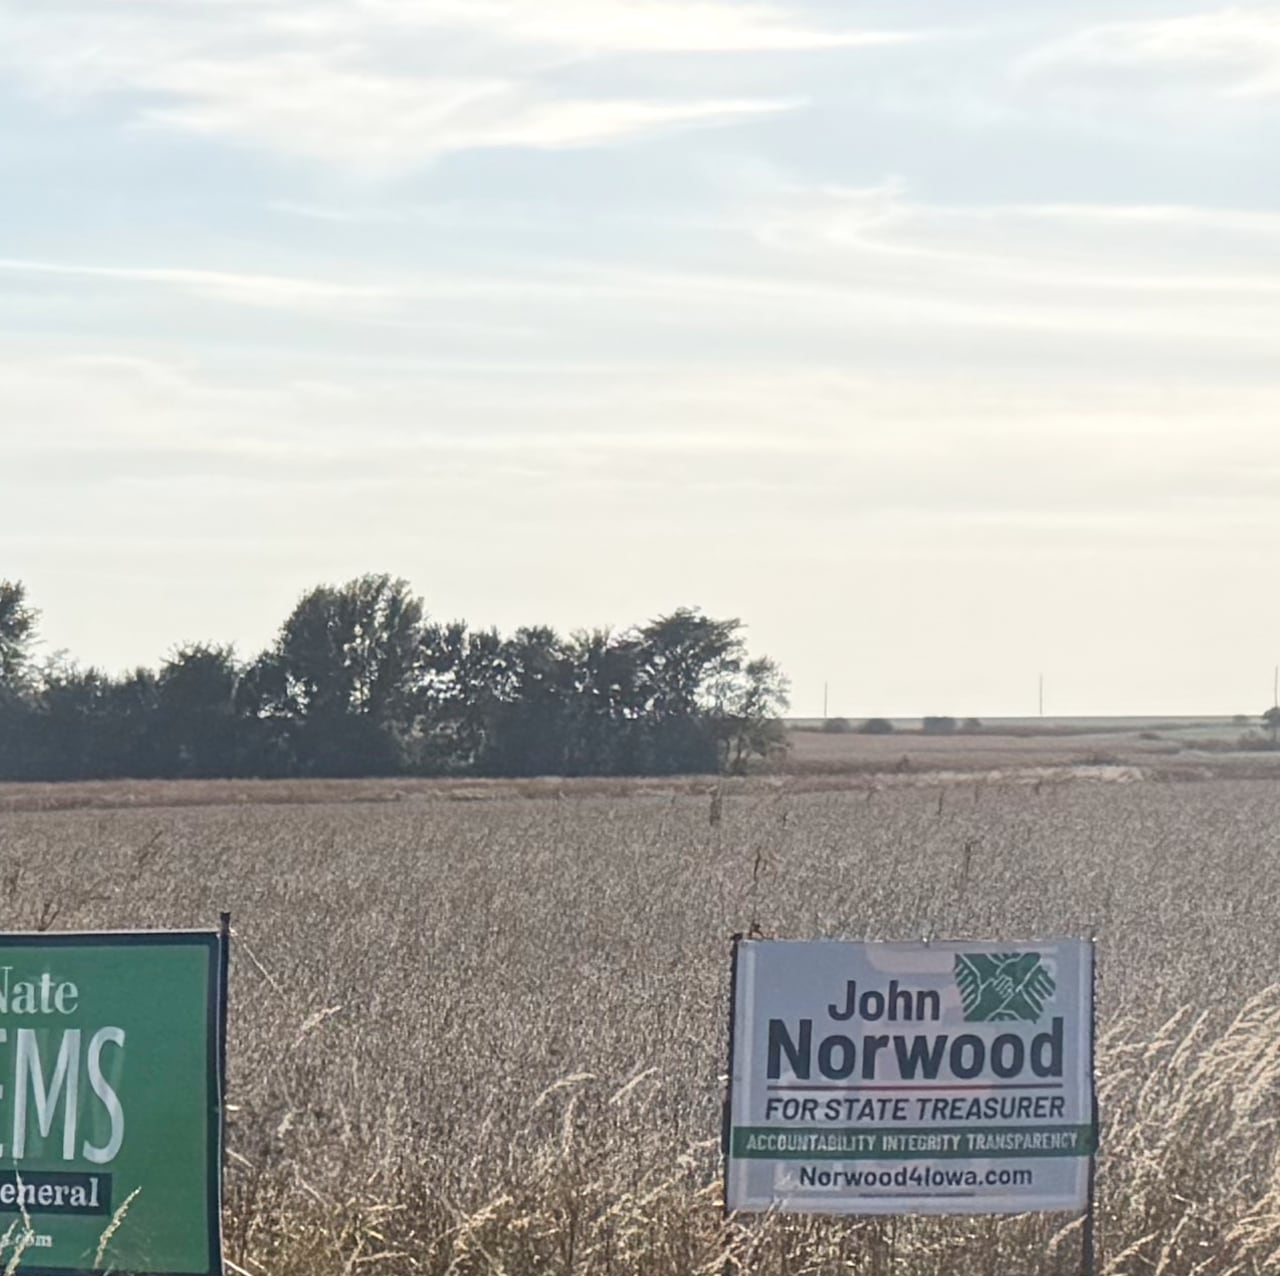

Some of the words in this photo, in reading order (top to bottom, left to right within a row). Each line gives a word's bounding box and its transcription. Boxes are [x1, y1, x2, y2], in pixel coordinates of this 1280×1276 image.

[828, 980, 940, 1022] John
[766, 1016, 1064, 1080] Norwood
[765, 1098, 818, 1121] FOR
[824, 1098, 908, 1121] STATE
[916, 1096, 1066, 1120] TREASURER
[746, 1134, 877, 1151] ACCOUNTABILITY
[883, 1134, 962, 1151] INTEGRITY
[966, 1132, 1079, 1150] TRANSPARENCY
[799, 1166, 1033, 1188] Norwood4Iowa.com
